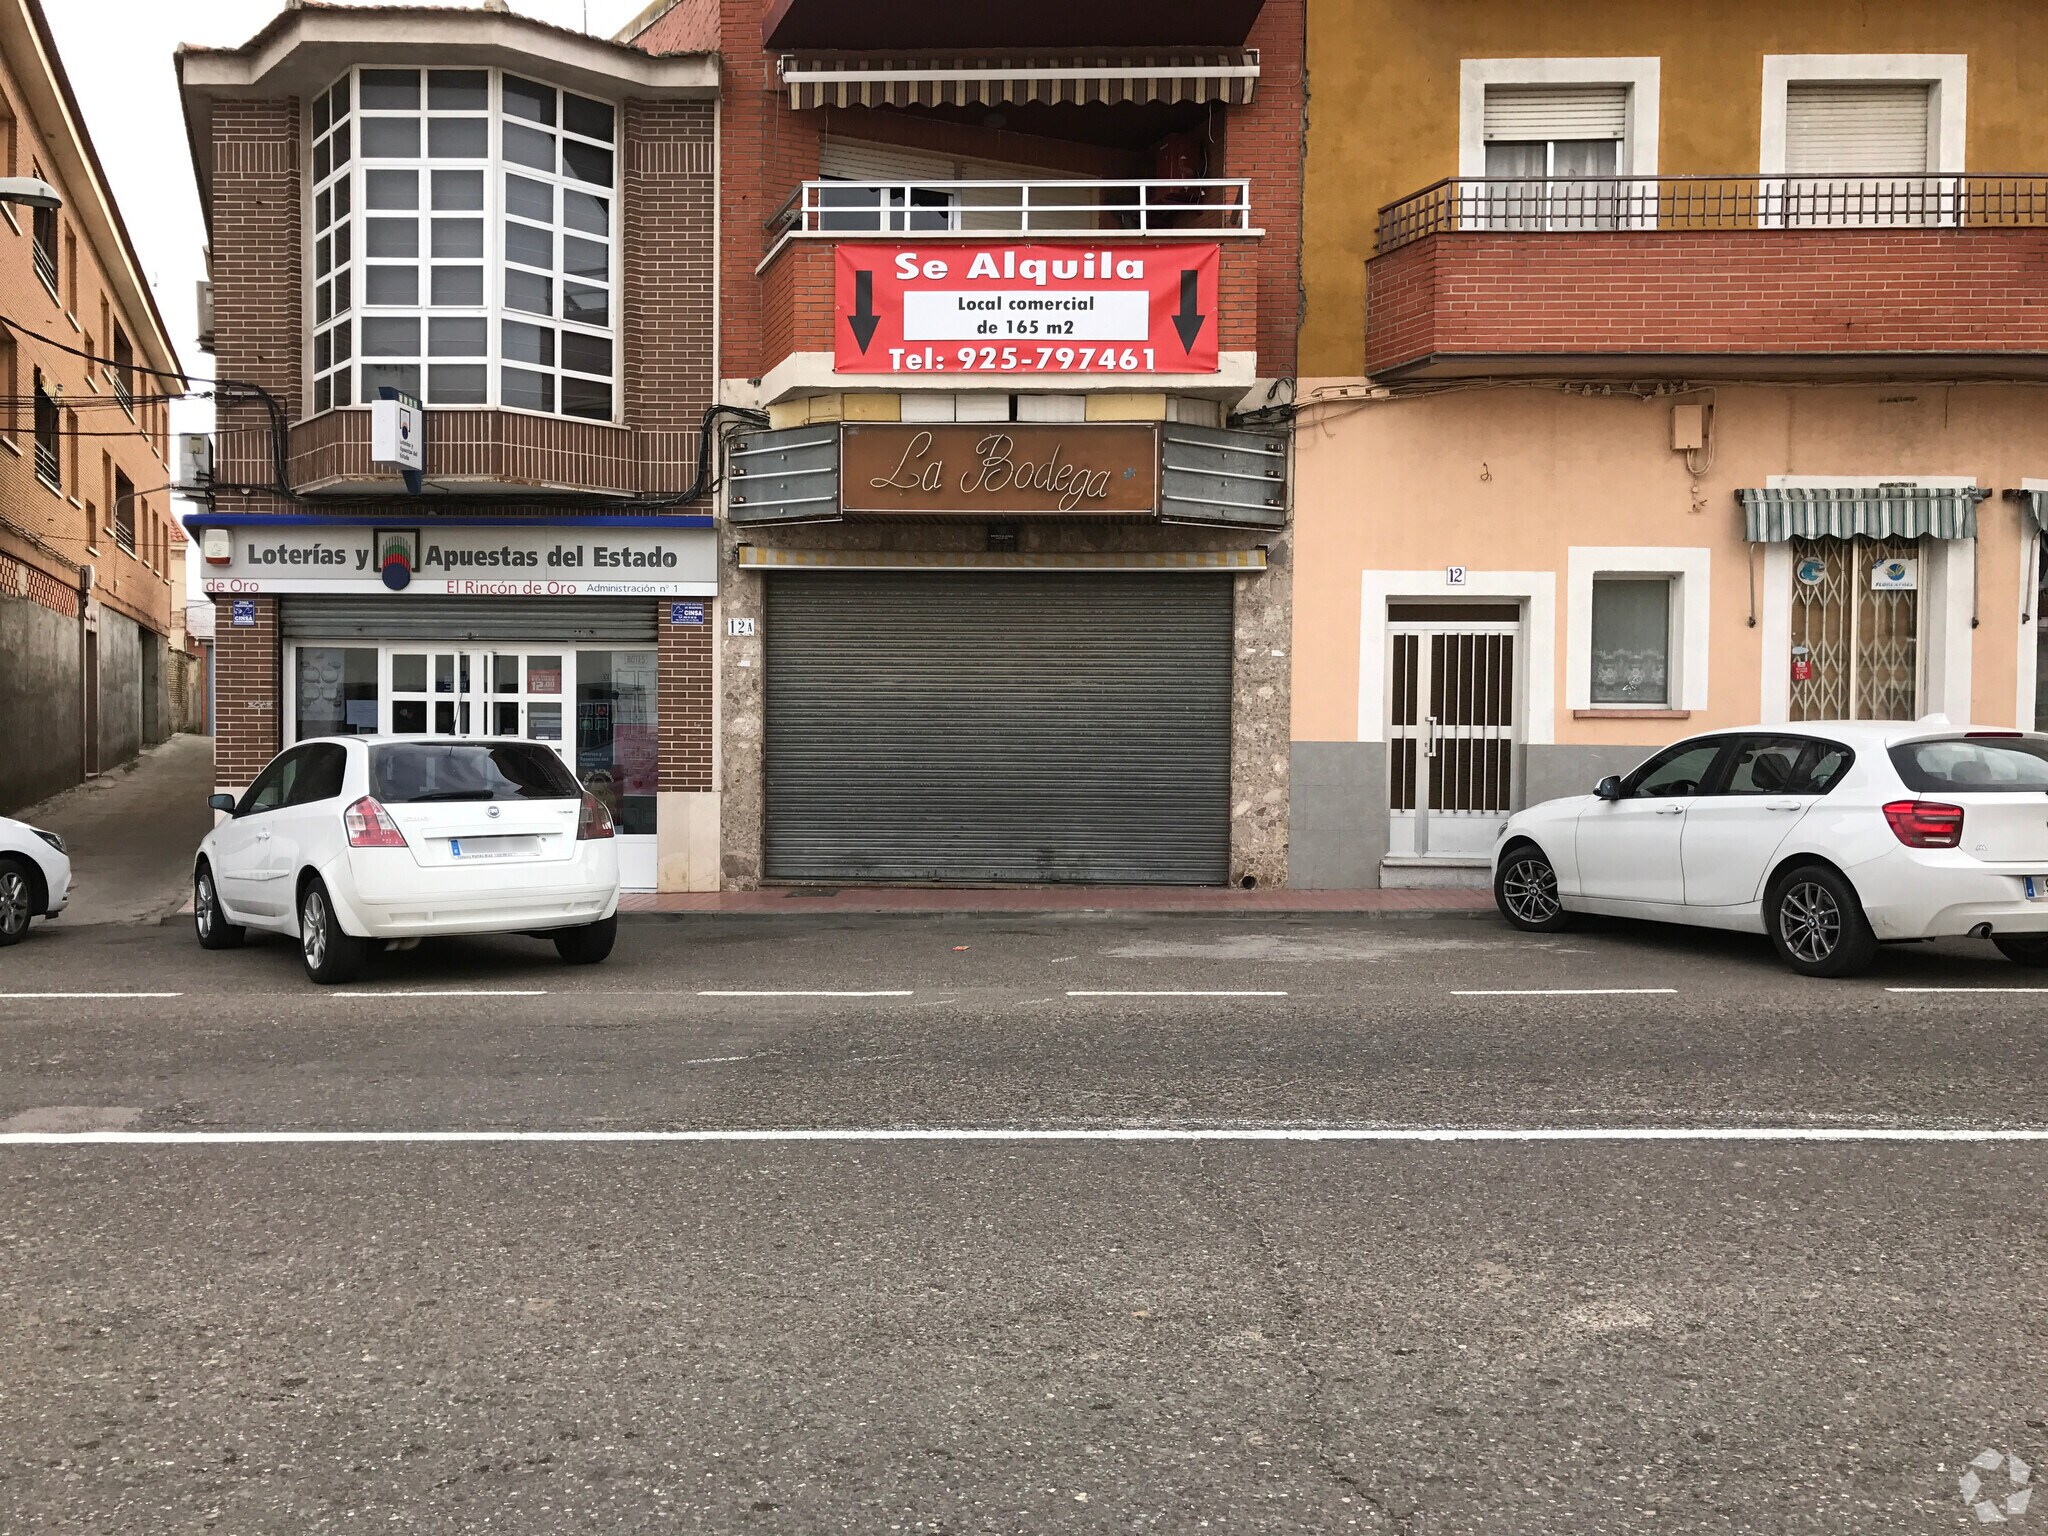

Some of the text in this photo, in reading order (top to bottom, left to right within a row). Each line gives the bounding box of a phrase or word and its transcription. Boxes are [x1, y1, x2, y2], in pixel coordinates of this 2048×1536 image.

[895, 251, 1144, 286] Se Alquila
[958, 296, 1094, 311] Local comercial
[977, 320, 1074, 335] de 165 m2
[889, 347, 1155, 371] Tel: 925-797461
[870, 432, 1111, 512] La Bodega
[248, 543, 677, 571] Loterías y Apuestas del Estado
[1449, 568, 1462, 583] 12
[206, 578, 259, 592] de Oro
[447, 580, 577, 595] El Rincón de Oro
[586, 583, 656, 593] Administración
[673, 584, 678, 593] 1
